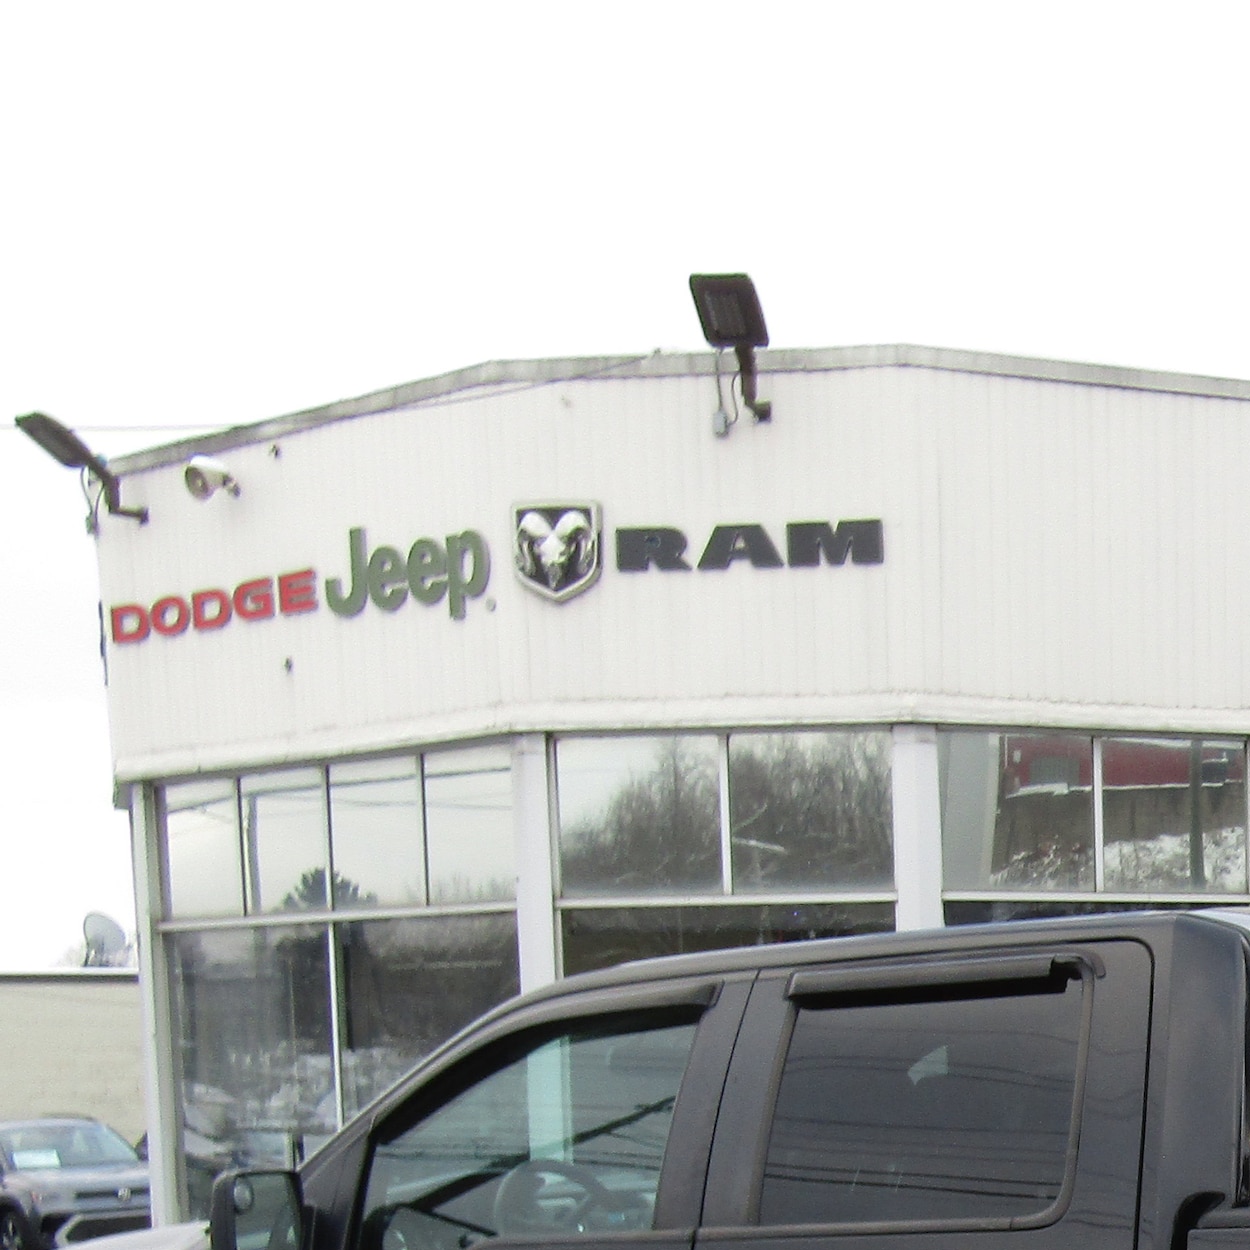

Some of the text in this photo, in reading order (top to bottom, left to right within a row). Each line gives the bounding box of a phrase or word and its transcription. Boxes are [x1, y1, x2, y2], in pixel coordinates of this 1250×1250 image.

[325, 526, 491, 621] Jeep
[614, 518, 885, 573] RAM
[110, 568, 319, 645] DODGE
